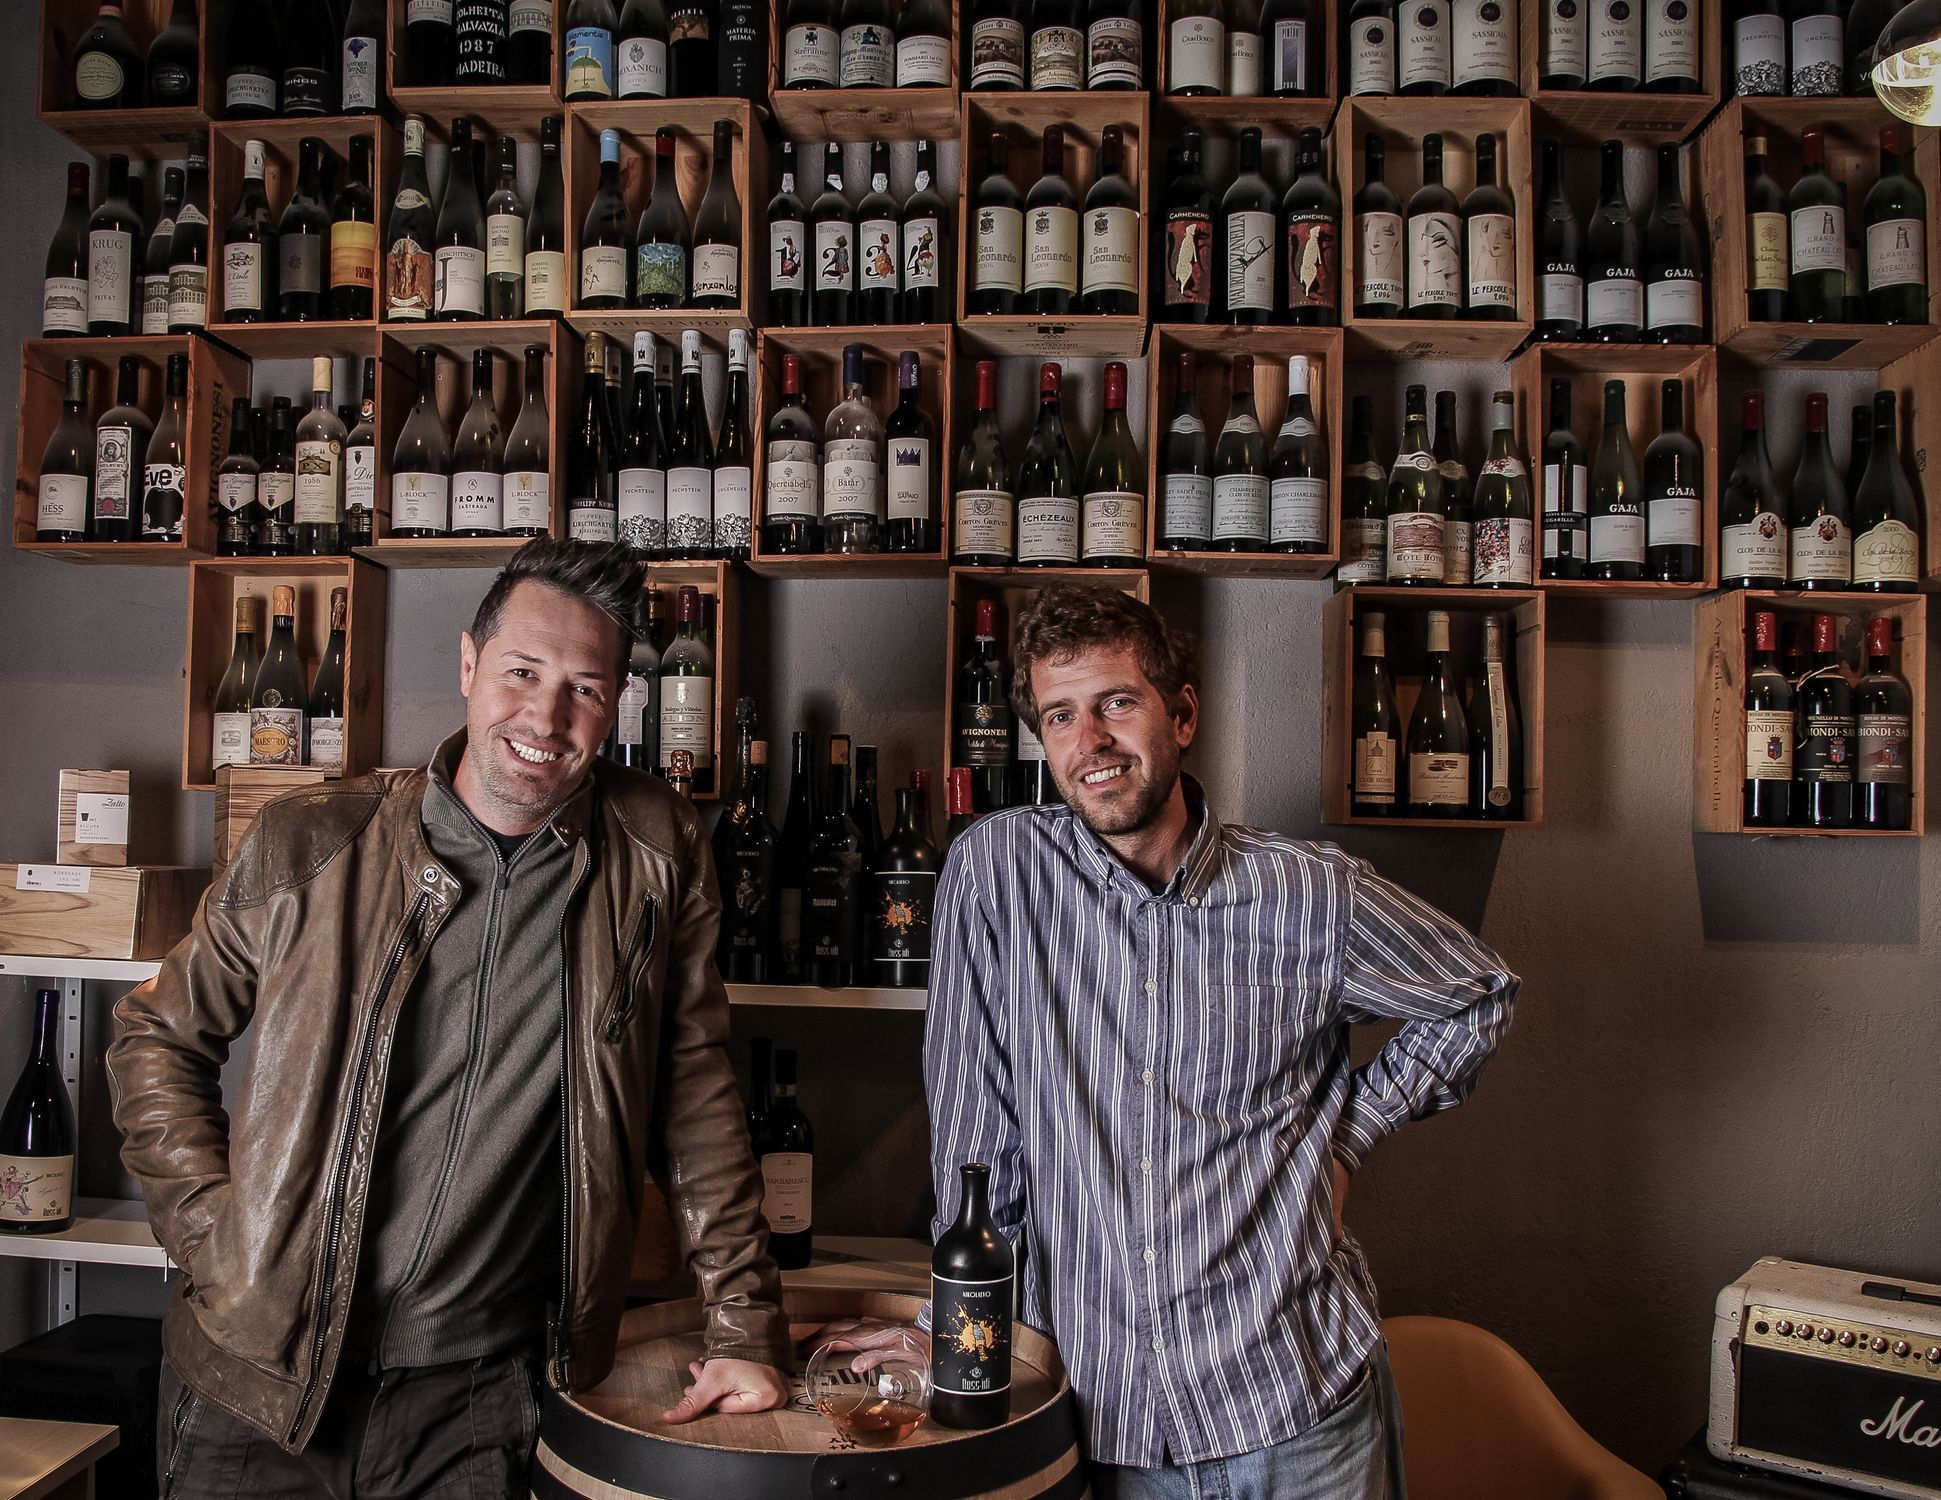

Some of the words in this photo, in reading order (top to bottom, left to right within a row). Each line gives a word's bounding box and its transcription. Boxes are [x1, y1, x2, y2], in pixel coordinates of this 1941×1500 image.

[459, 39, 494, 54] 1987
[456, 60, 506, 79] MADEIRA
[1169, 212, 1209, 220] CARMENERO
[1292, 214, 1333, 222] CARMENERO
[92, 239, 123, 249] KRUG
[1034, 245, 1050, 253] San
[1093, 247, 1108, 255] San
[822, 248, 840, 277] 2
[866, 246, 882, 277] 3
[977, 252, 1016, 264] Leonardo
[1031, 252, 1072, 263] Leonardo
[1090, 254, 1132, 265] Leonardo
[1547, 263, 1576, 273] GAJA
[1606, 268, 1636, 278] GAJA
[1665, 268, 1694, 278] GAJA
[1666, 487, 1696, 497] GAJA
[455, 495, 495, 504] FROMM
[42, 505, 64, 513] HESS
[1609, 504, 1638, 513] GAJA
[102, 798, 126, 807] Zalto
